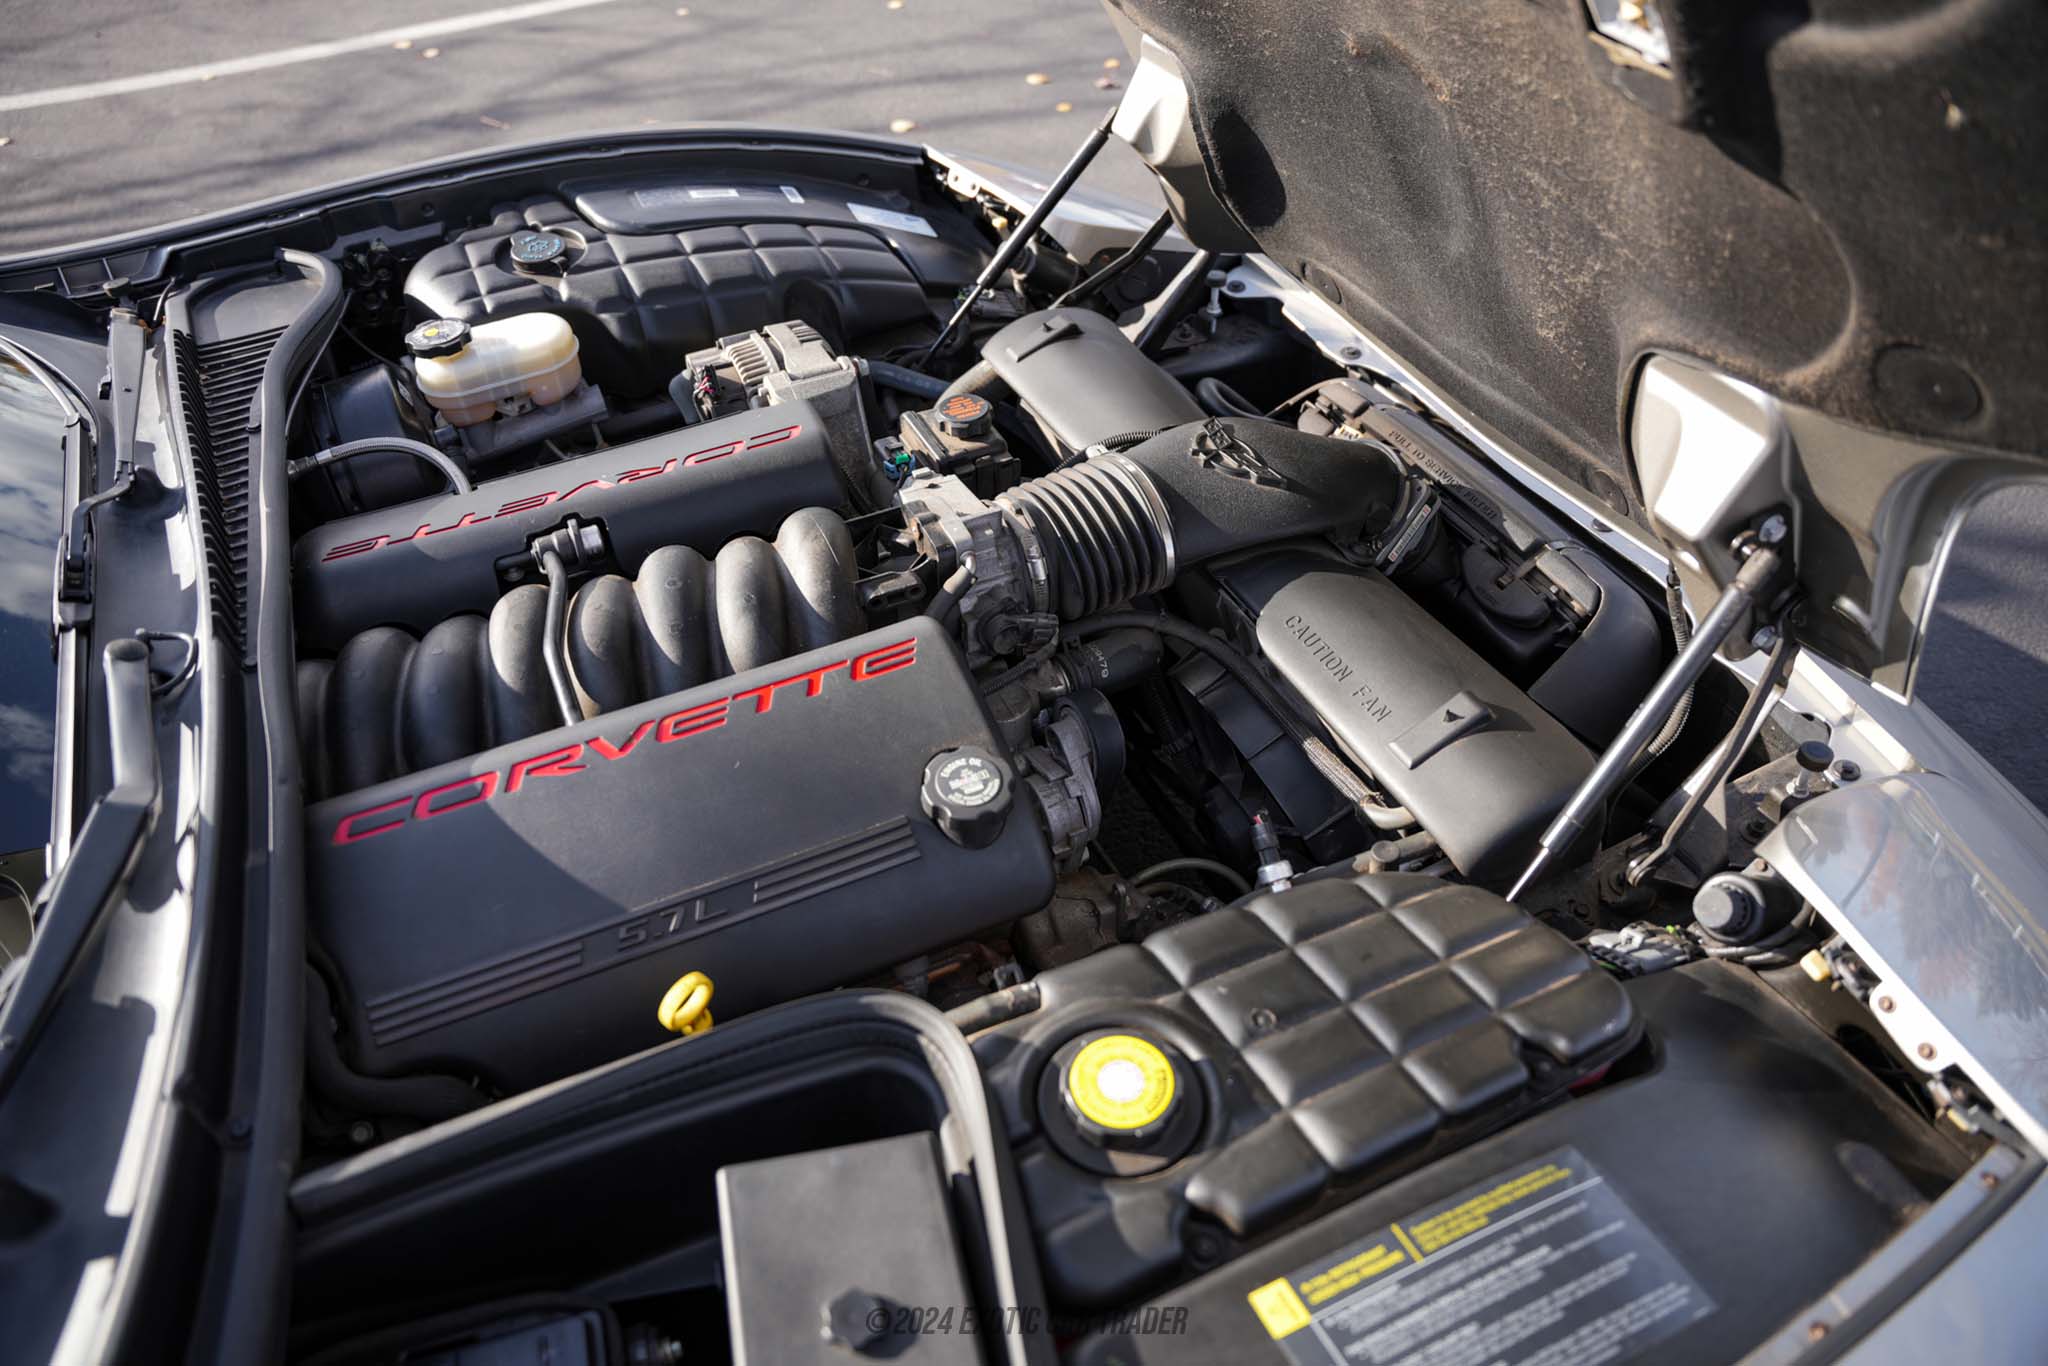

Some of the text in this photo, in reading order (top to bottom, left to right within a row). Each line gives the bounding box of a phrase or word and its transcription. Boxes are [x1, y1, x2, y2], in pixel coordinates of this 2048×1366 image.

[321, 424, 803, 564] CORVETTE
[1388, 430, 1411, 452] PULL
[1412, 448, 1426, 461] TO
[1285, 615, 1392, 722] CAUTION FAN
[333, 637, 918, 846] CORVETTE
[617, 899, 729, 952] 5.7L
